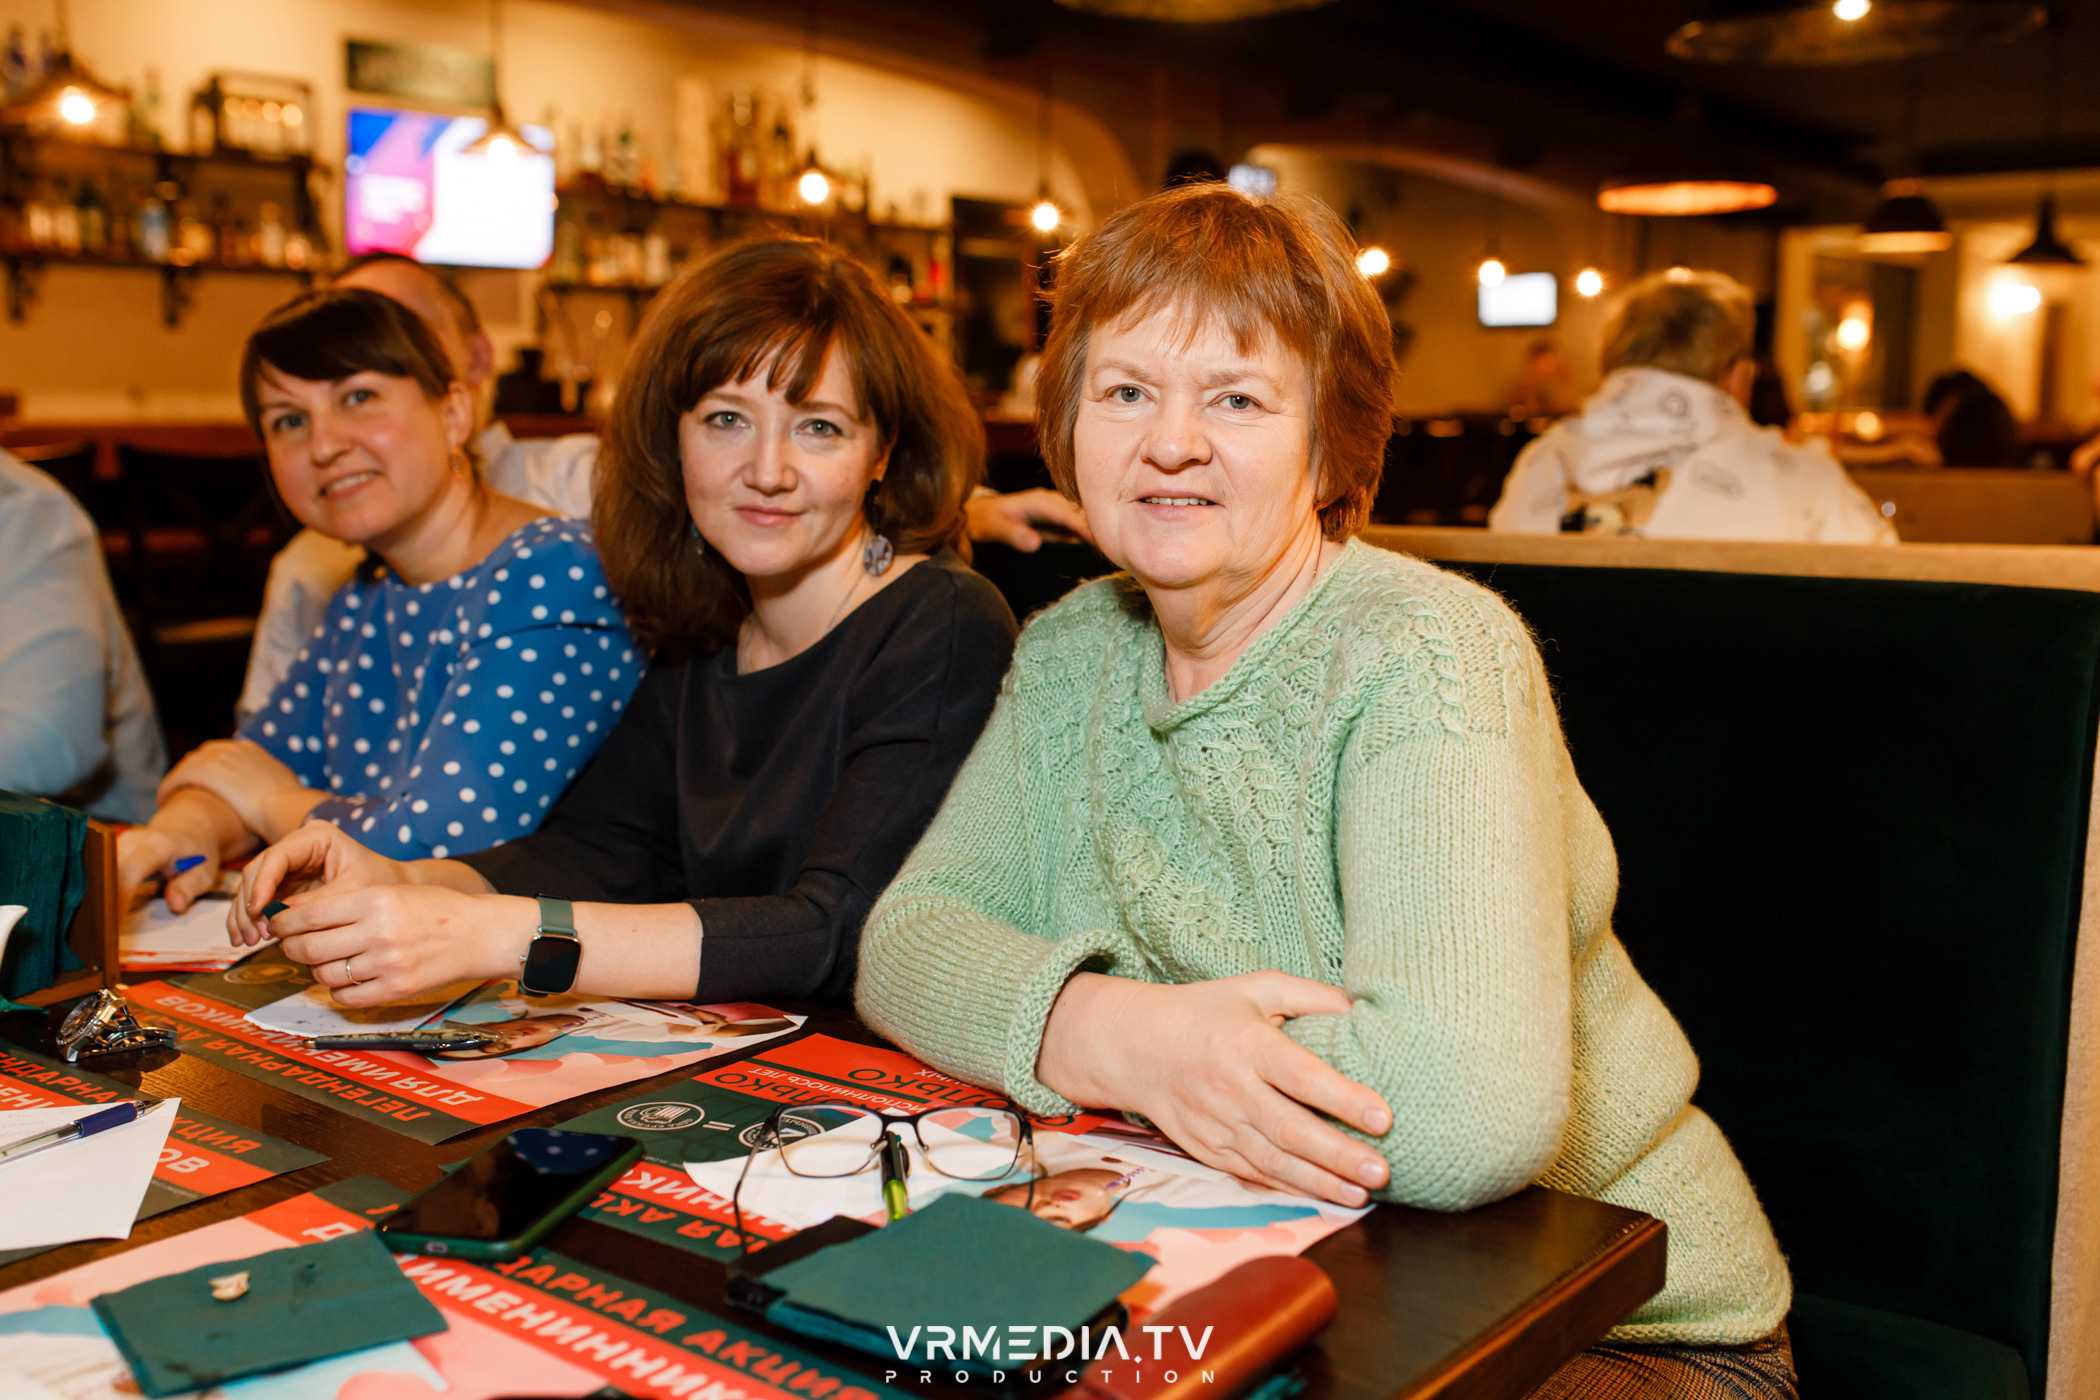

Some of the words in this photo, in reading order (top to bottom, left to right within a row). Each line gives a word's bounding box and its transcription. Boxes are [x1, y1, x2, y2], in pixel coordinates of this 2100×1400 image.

[202, 1038, 432, 1122] ЛЕГЕНДАРНАЯ
[395, 1075, 485, 1106] ДЛЯ
[747, 1067, 786, 1082] ЛЕТ
[786, 1075, 927, 1114] ИСПОЛНИЛОСЬ
[404, 1261, 766, 1400] ИМЕНИННИК
